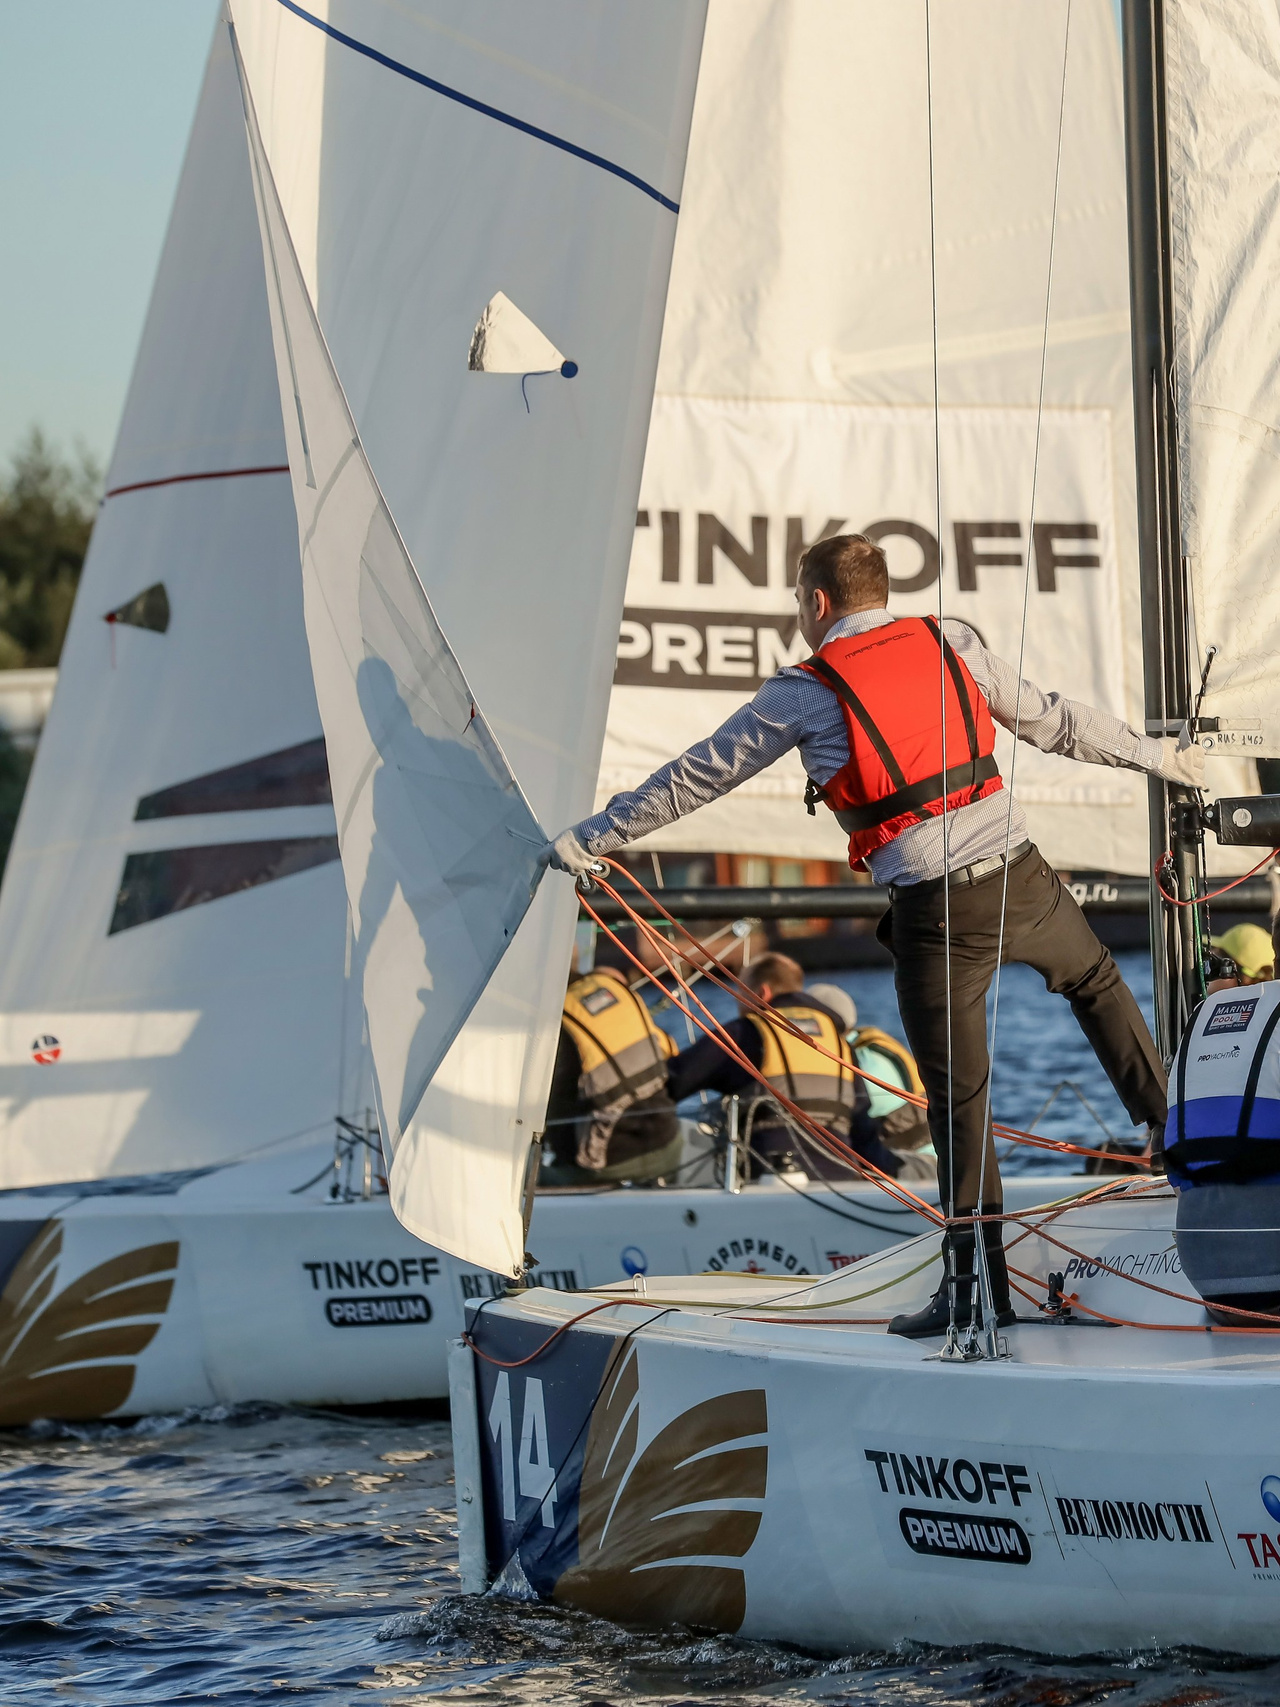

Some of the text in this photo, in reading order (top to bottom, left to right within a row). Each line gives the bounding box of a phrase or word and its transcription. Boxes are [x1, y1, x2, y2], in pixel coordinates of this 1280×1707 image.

[635, 509, 1101, 593] INKOFF
[615, 619, 813, 679] PREM
[1217, 733, 1236, 744] RUS
[1212, 1016, 1235, 1024] POOL
[1215, 1003, 1255, 1015] MARINE
[1197, 1050, 1240, 1062] PROYACHTING
[302, 1256, 440, 1290] TINKOFF
[1063, 1252, 1182, 1280] PROYACHTING
[329, 1299, 427, 1322] PREMIUM
[489, 1370, 558, 1529] 14
[863, 1448, 1033, 1507] TINKOFF
[905, 1517, 1024, 1556] PREMIUM
[1054, 1496, 1214, 1543] ВЕДОМОСТИ
